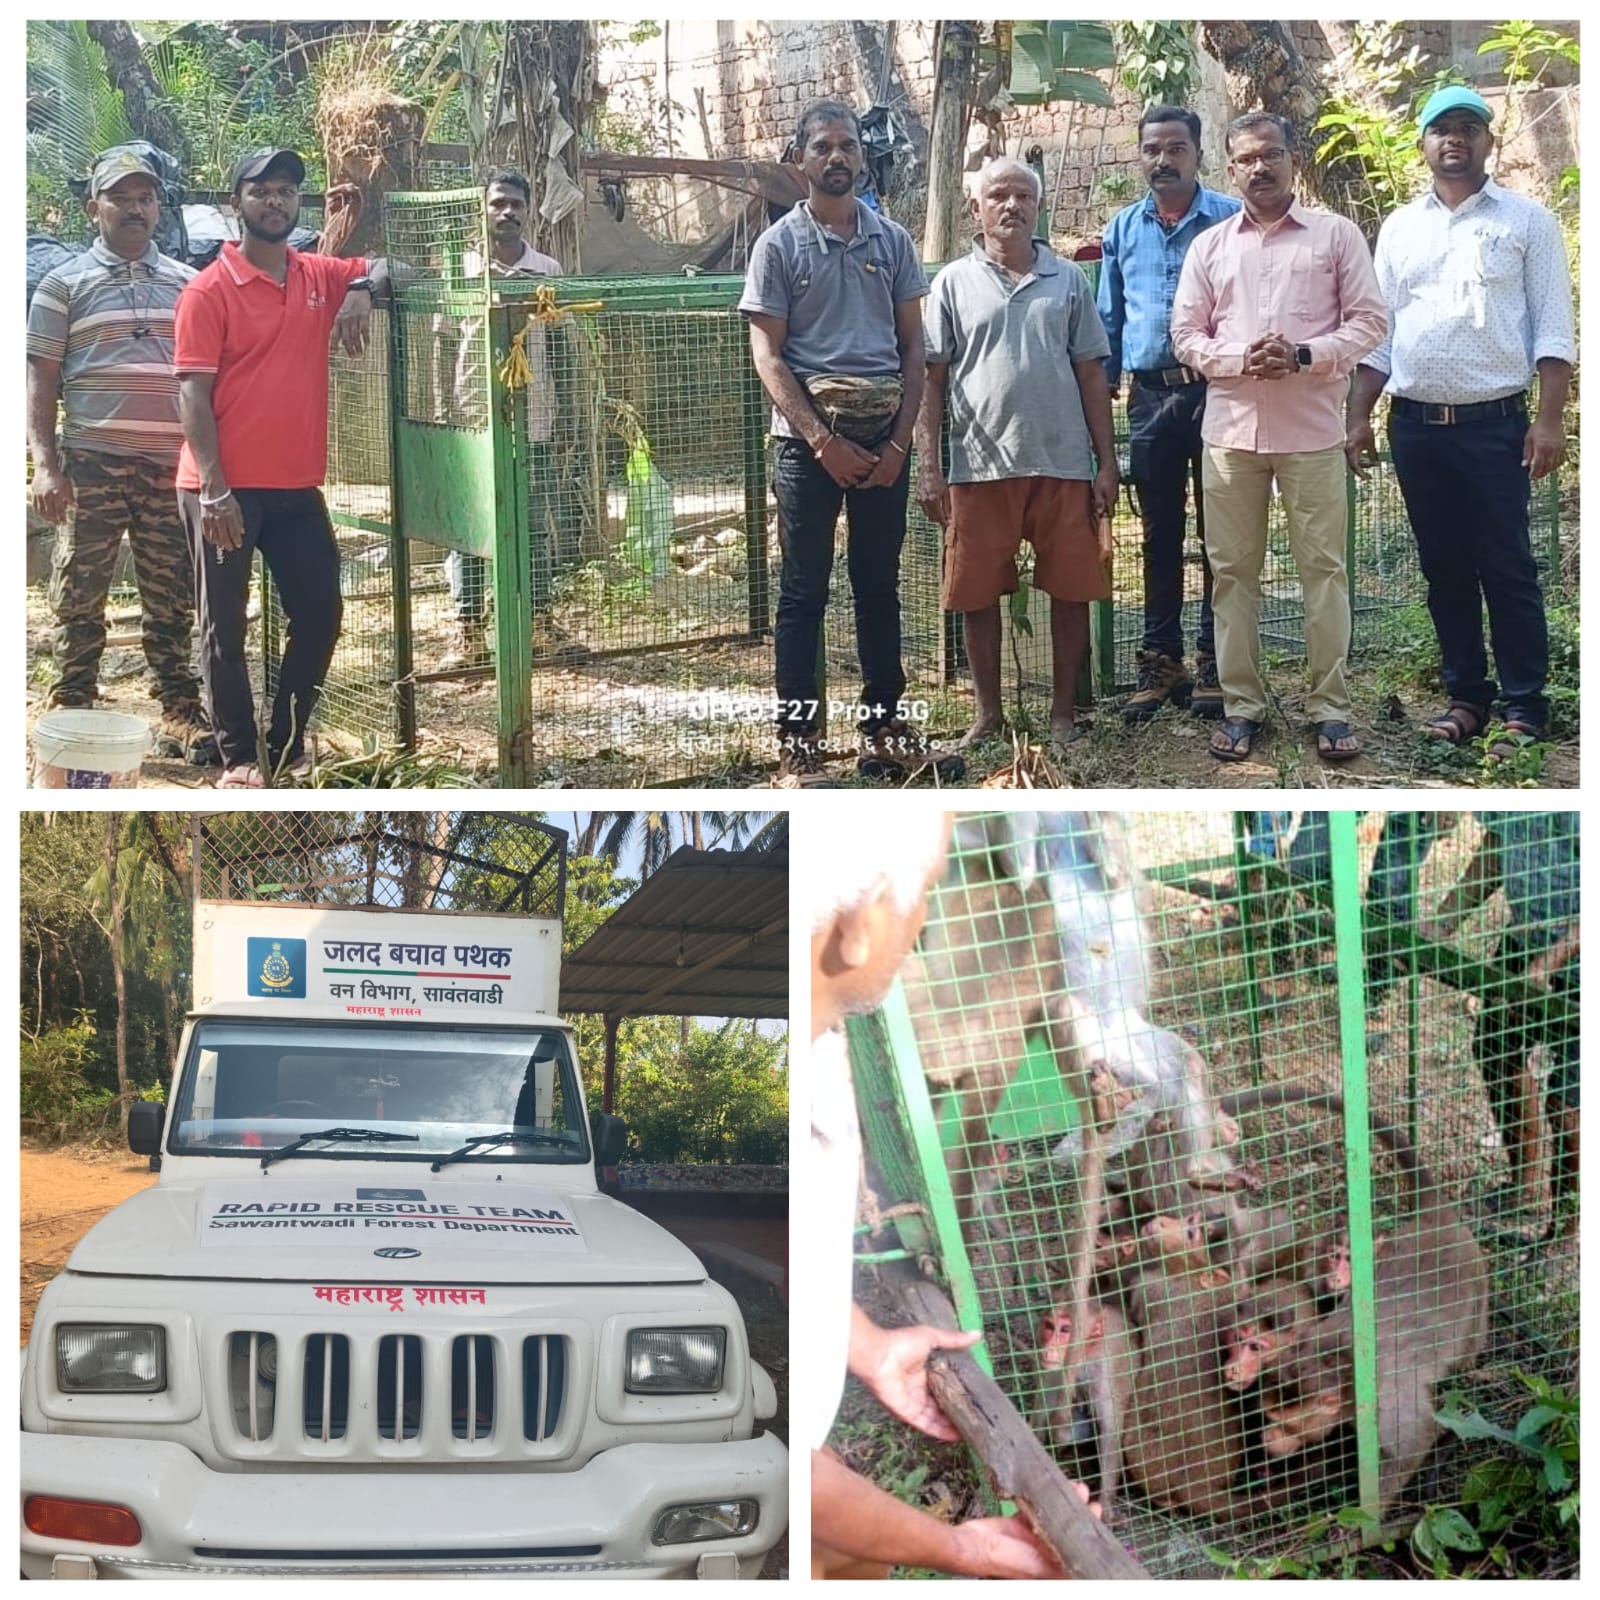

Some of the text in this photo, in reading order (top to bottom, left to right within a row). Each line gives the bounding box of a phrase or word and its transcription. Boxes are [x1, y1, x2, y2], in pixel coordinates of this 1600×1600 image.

[323, 941, 512, 969] जलद बचाव पथक
[330, 980, 503, 1004] वन विभाग, सावंतवाडी
[346, 1006, 422, 1017] महाराष्ट्र शासन
[219, 1202, 565, 1220] RAPID RESCUE TEAM
[209, 1218, 580, 1237] Sawantwadi Forest Department
[312, 1286, 486, 1312] महाराष्ट्र शासन
